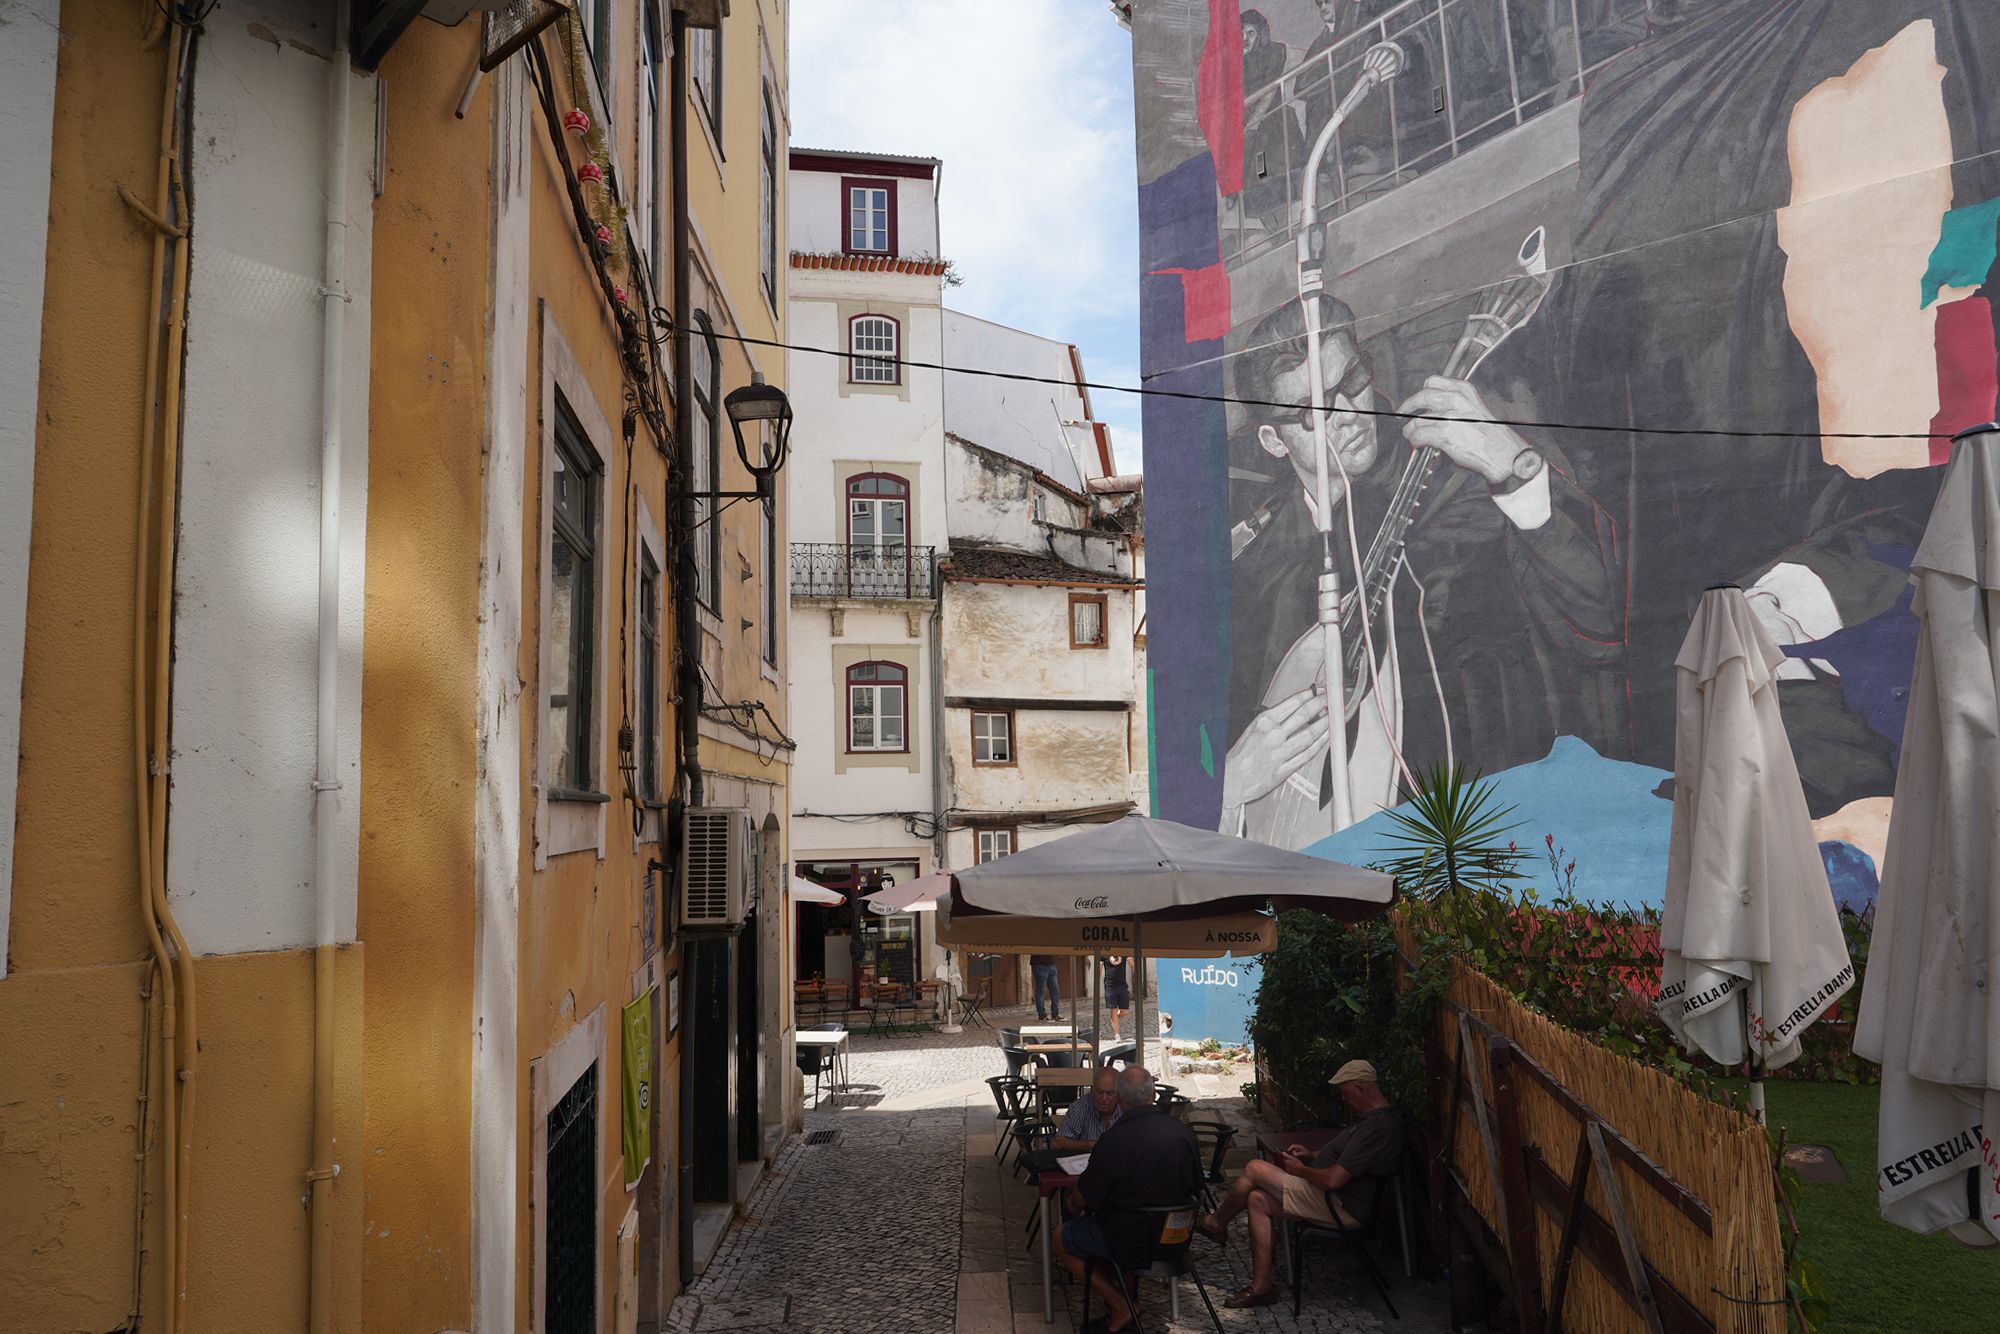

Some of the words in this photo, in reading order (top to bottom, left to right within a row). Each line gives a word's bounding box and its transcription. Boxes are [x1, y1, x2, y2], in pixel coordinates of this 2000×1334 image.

[1081, 926, 1129, 942] CORAL
[1205, 930, 1215, 943] À
[1218, 931, 1261, 943] NOSSA
[1181, 964, 1238, 988] RUÍDO
[1658, 979, 1686, 1003] RELL
[1683, 987, 1722, 1015] RELLA
[1777, 990, 1827, 1036] ESTRELLA
[1883, 1130, 1975, 1187] ESTRELLA
